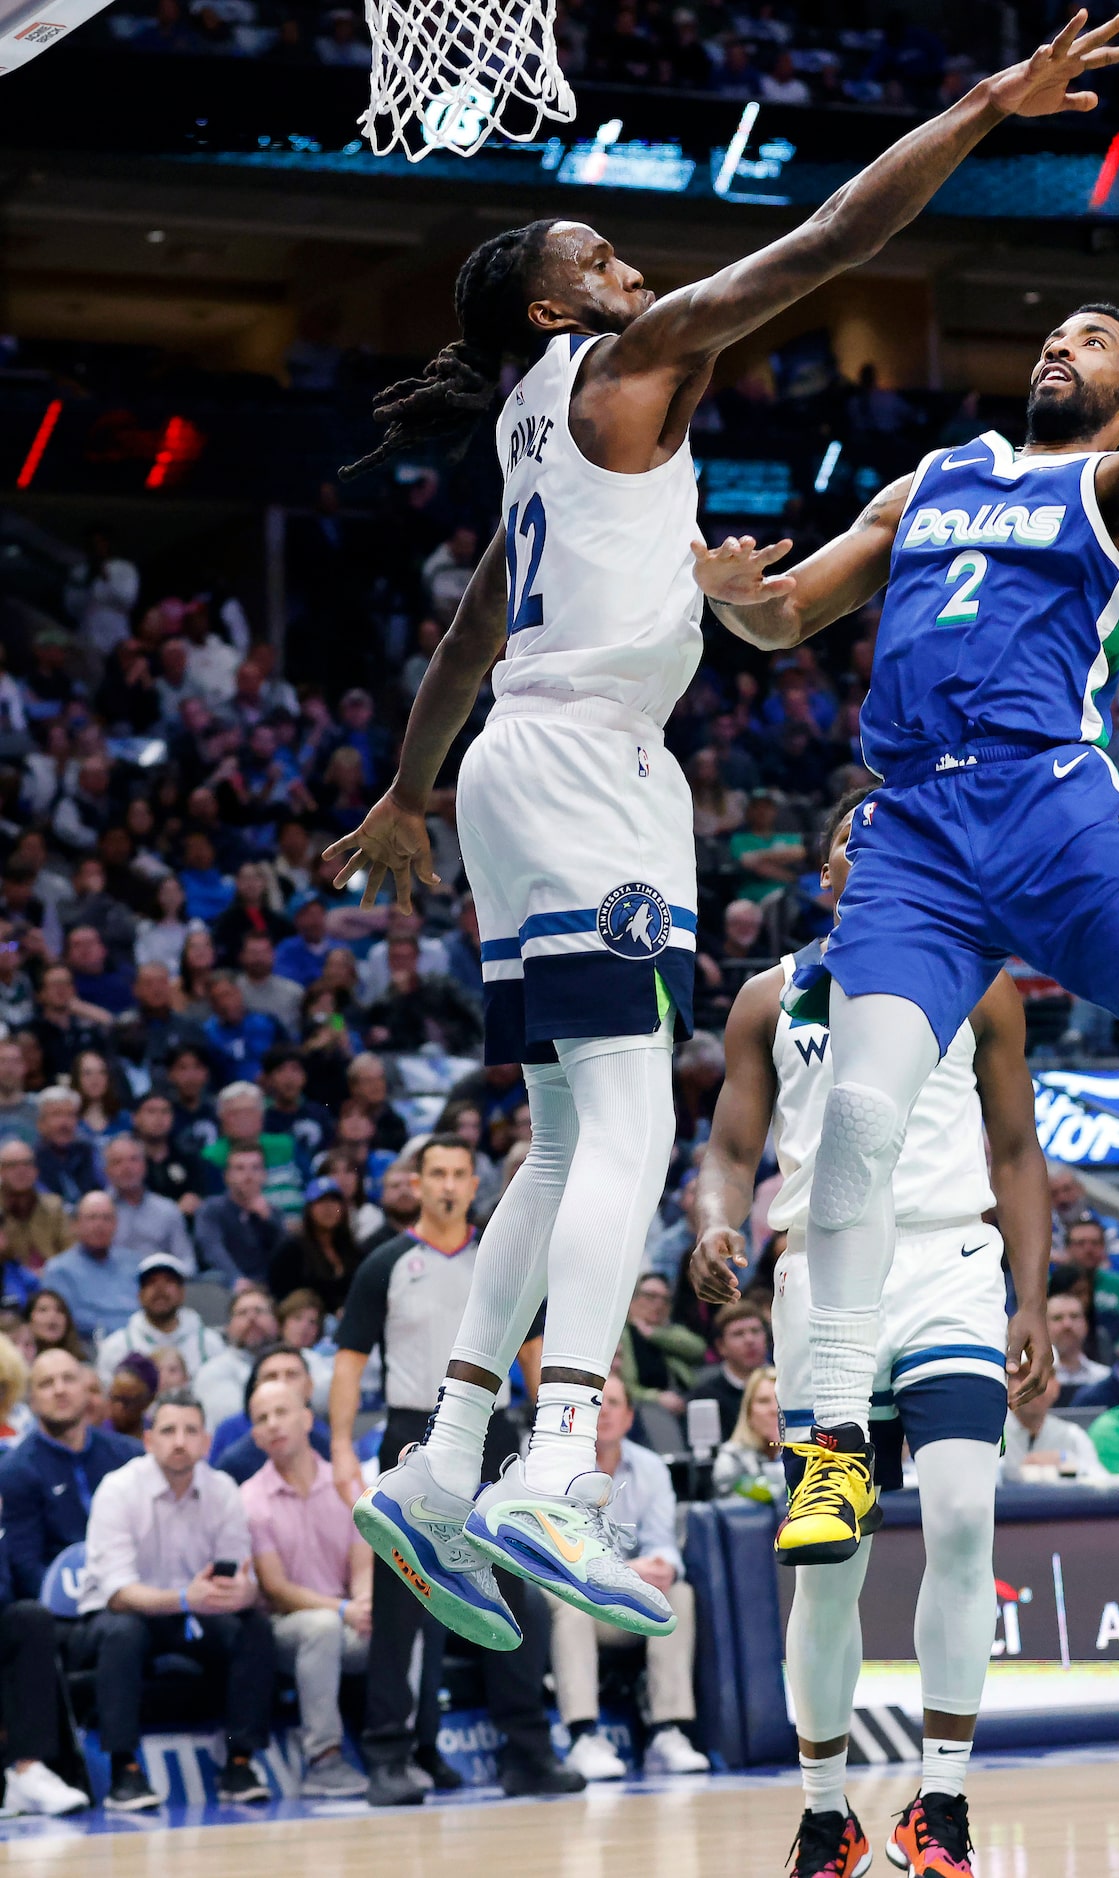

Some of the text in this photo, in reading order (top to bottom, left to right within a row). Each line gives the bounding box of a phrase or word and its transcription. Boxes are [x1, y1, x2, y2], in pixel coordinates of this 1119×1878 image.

[901, 501, 1067, 549] Dallas
[935, 549, 989, 627] 2
[635, 883, 670, 946] TIMBERWOLVES
